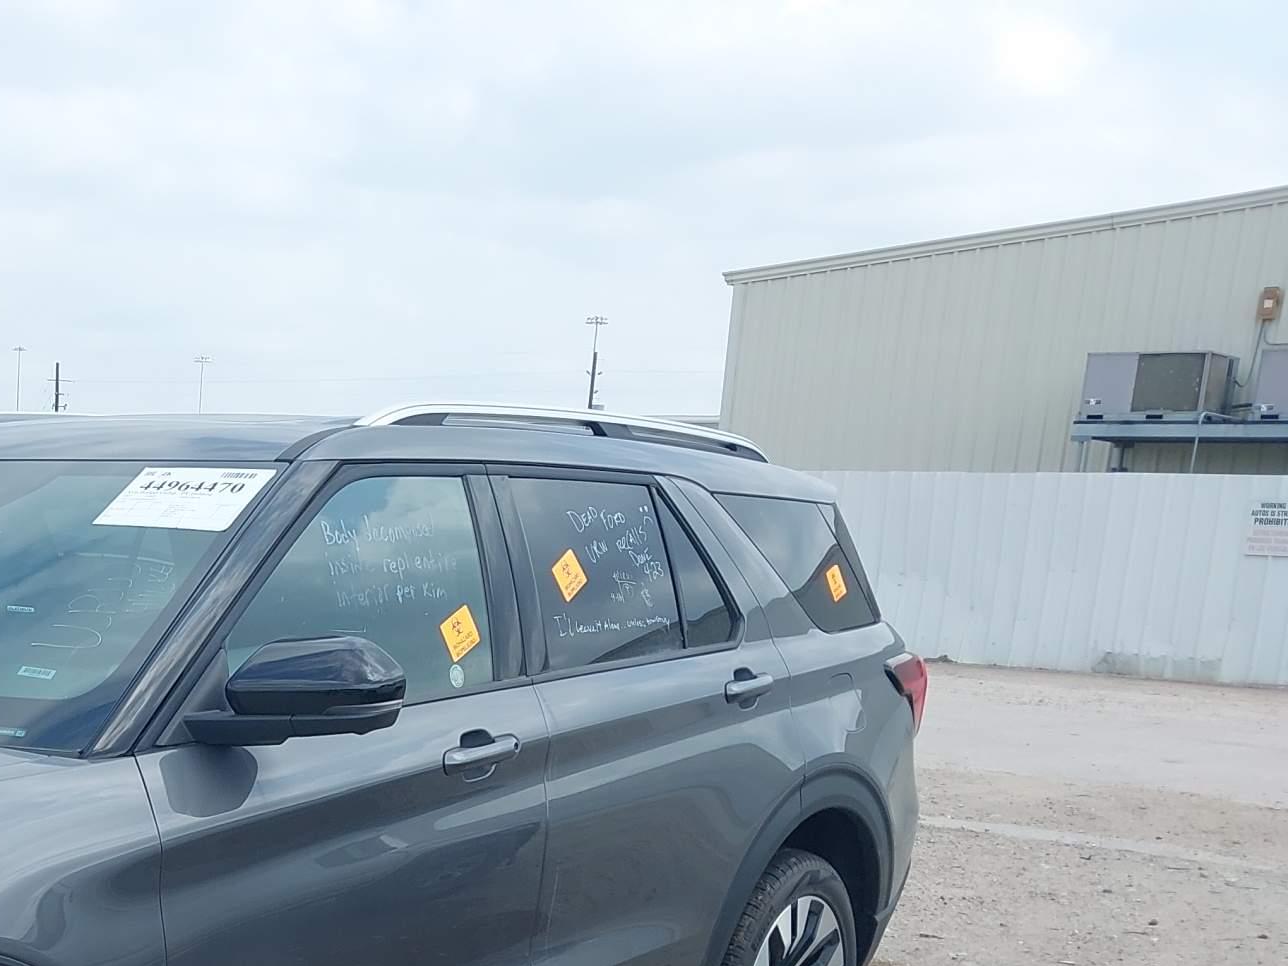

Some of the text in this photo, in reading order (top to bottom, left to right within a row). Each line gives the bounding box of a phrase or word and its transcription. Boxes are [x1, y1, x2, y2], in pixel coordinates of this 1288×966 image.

[140, 480, 246, 495] 44964470
[566, 507, 627, 534] DEAD FORD
[320, 519, 360, 552] Body
